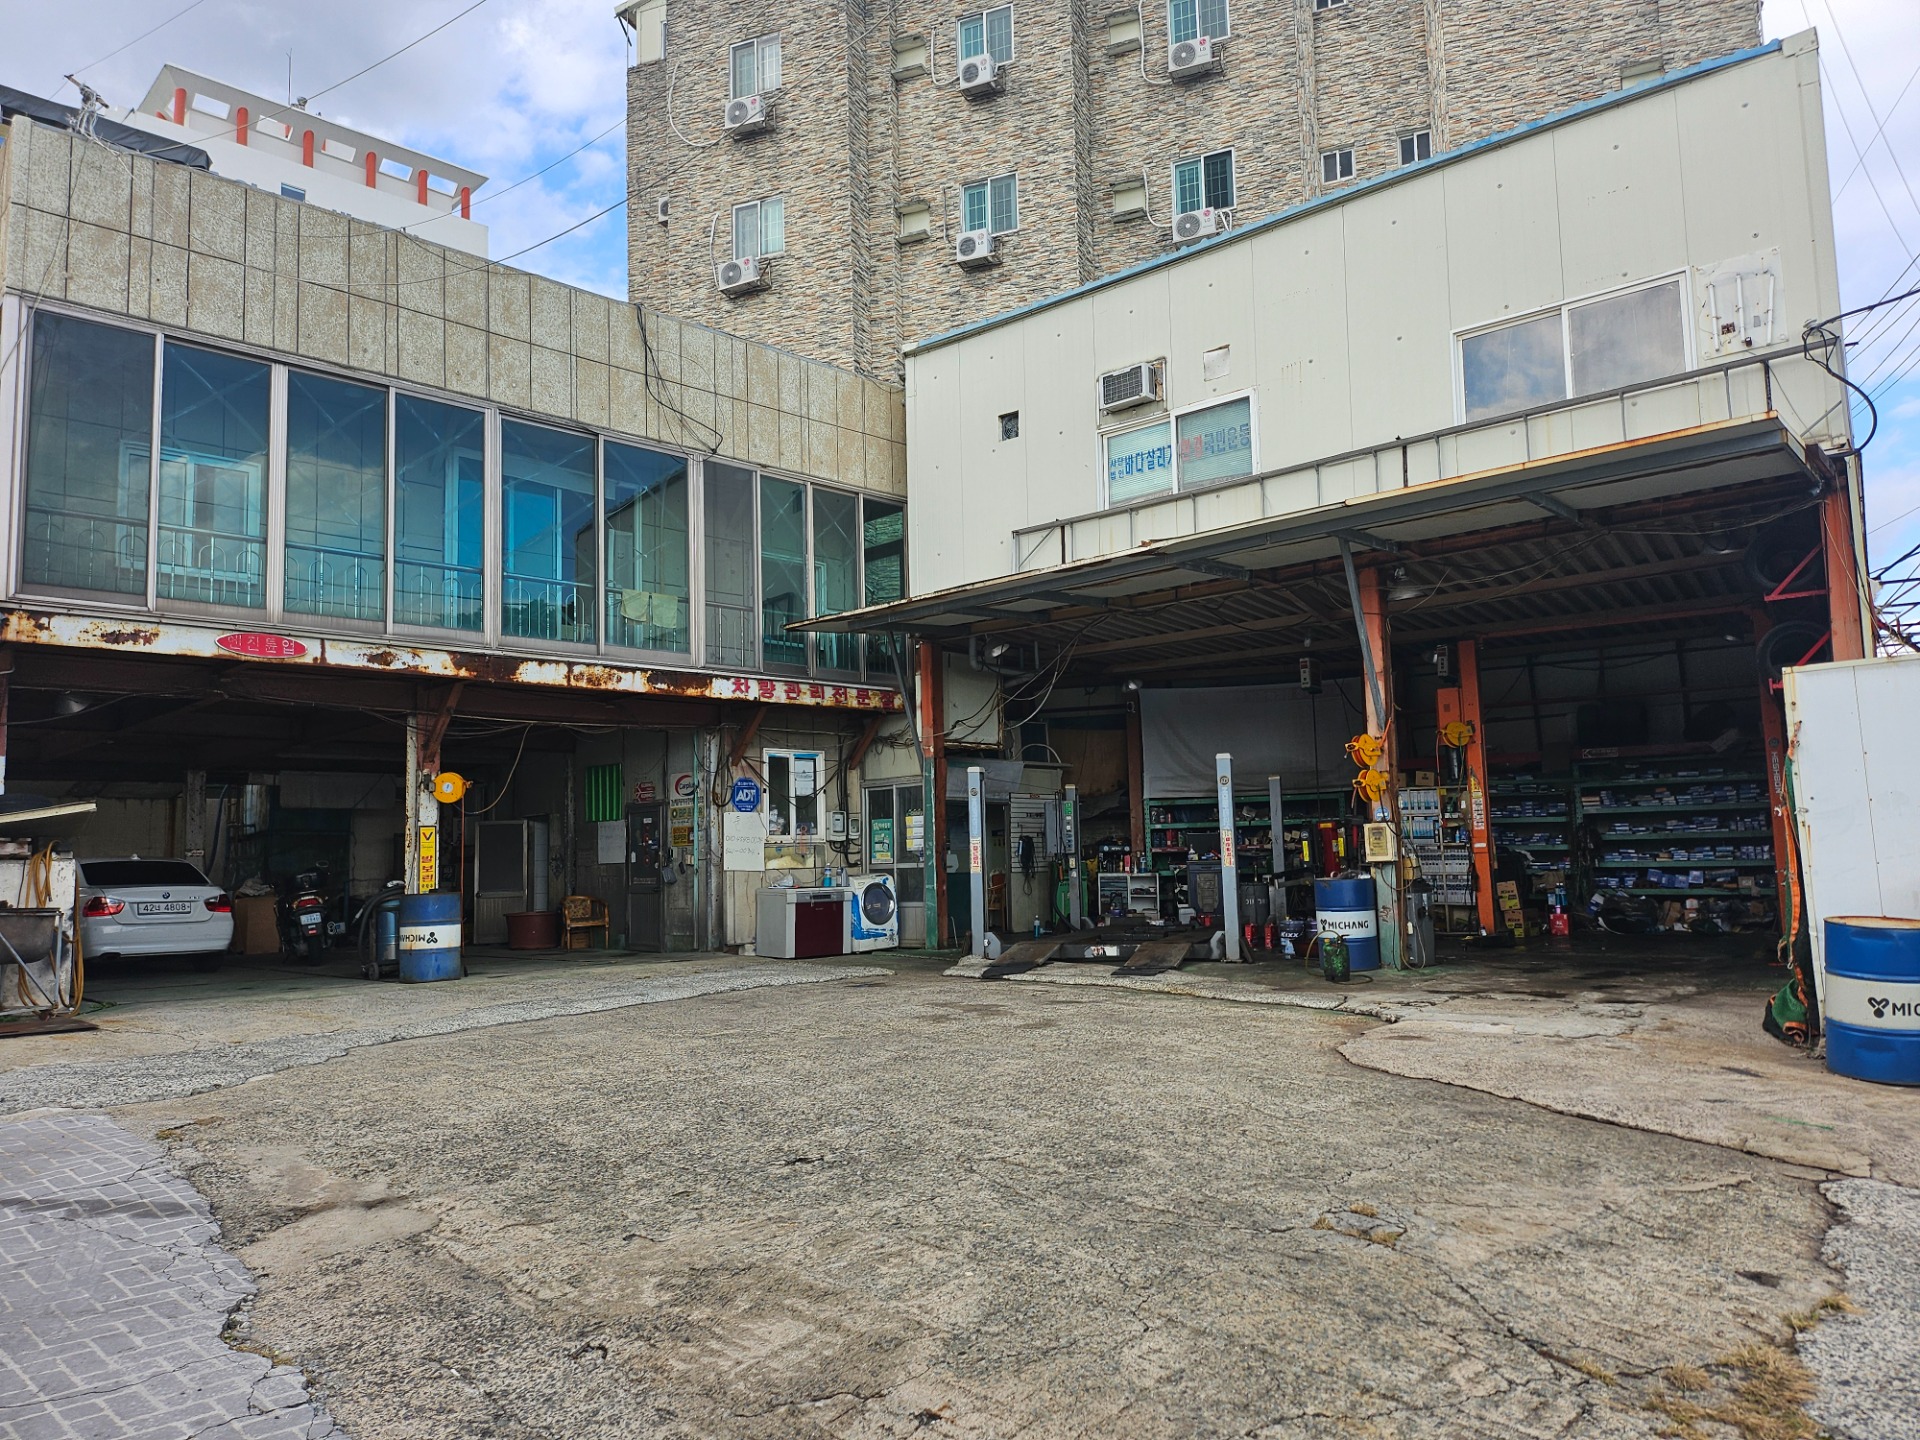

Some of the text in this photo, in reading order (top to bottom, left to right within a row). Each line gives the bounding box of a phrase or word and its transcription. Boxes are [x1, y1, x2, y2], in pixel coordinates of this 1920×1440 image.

[732, 677, 895, 710] 차량관리전문점
[1771, 751, 1782, 794] HESHBON
[736, 789, 755, 801] ADT
[164, 902, 187, 912] 4808
[1327, 920, 1369, 930] MICHANG
